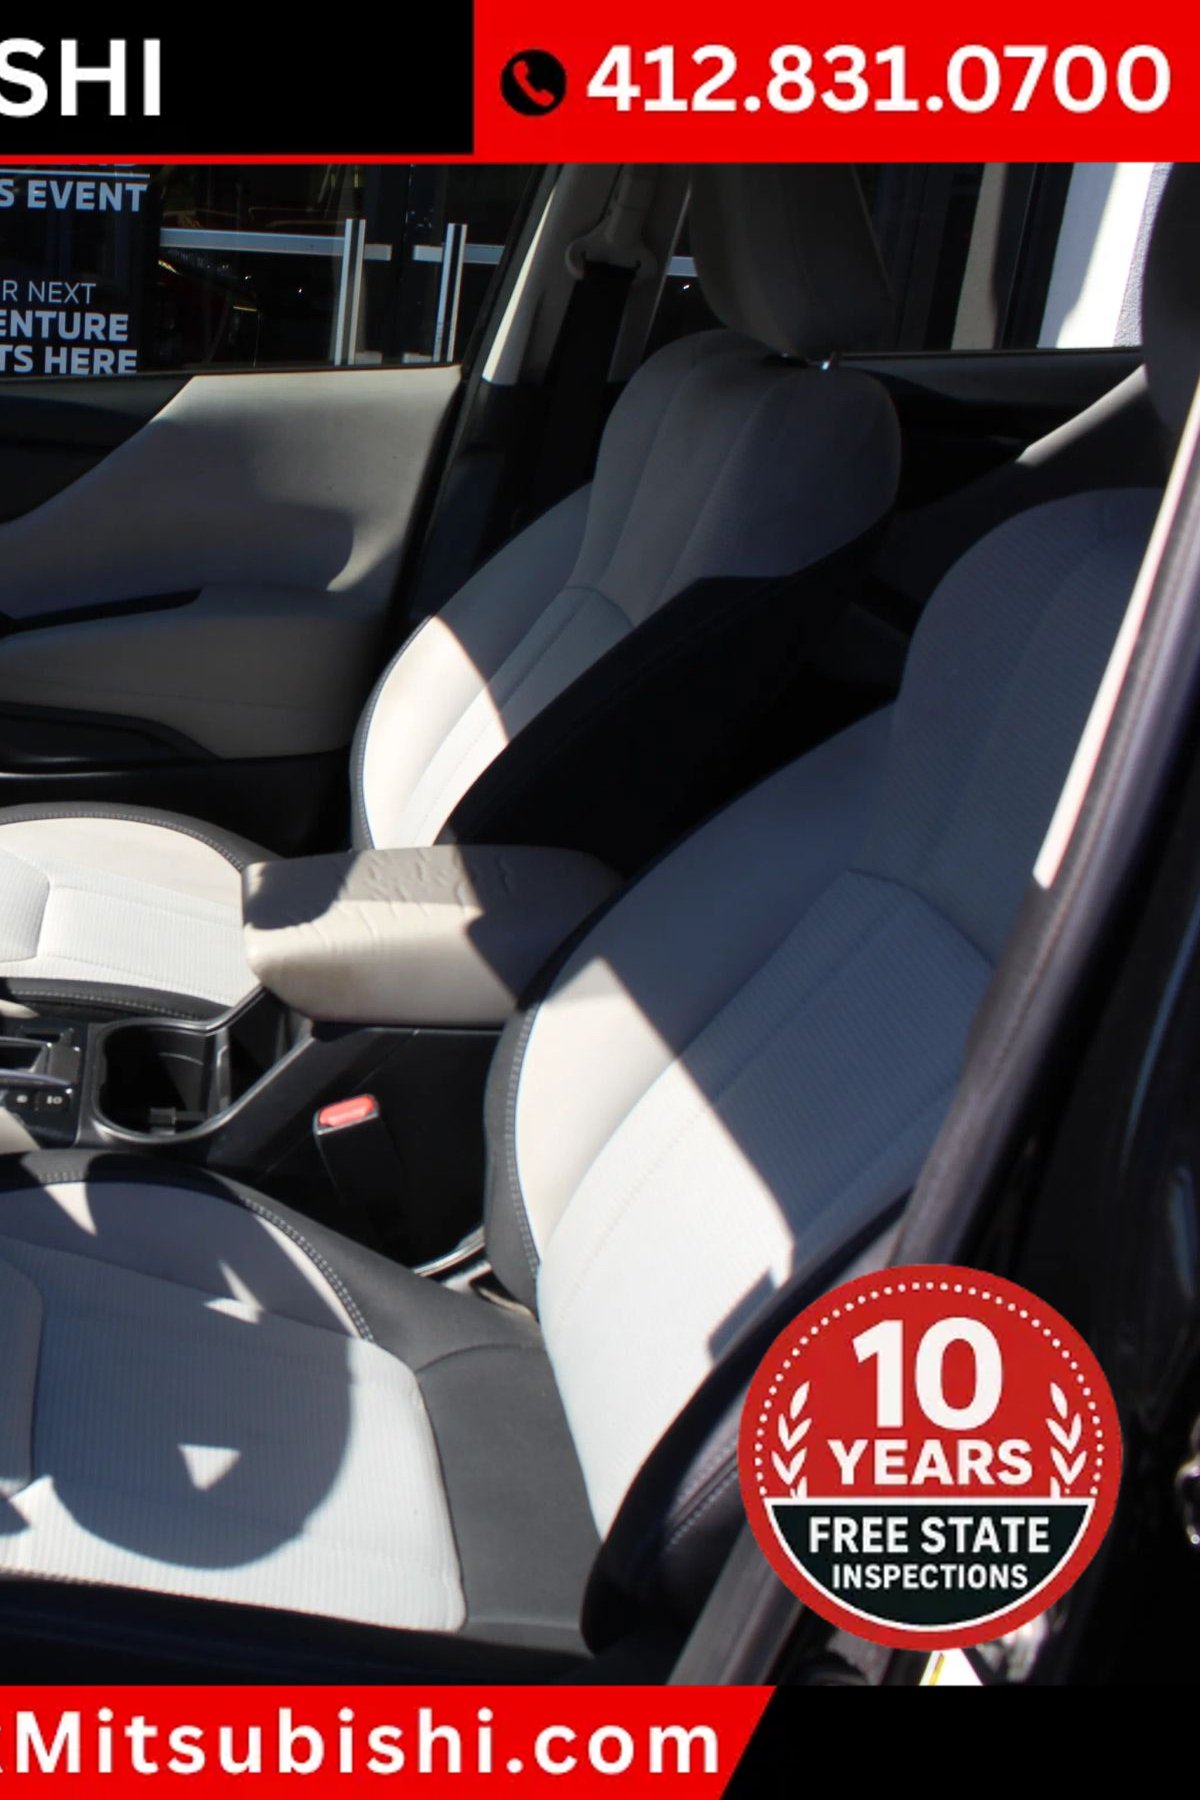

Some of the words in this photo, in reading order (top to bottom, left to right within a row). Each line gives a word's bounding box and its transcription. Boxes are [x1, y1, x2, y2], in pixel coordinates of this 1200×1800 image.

[27, 180, 148, 212] EVENT
[28, 281, 96, 304] NEXT
[44, 346, 138, 375] HERE
